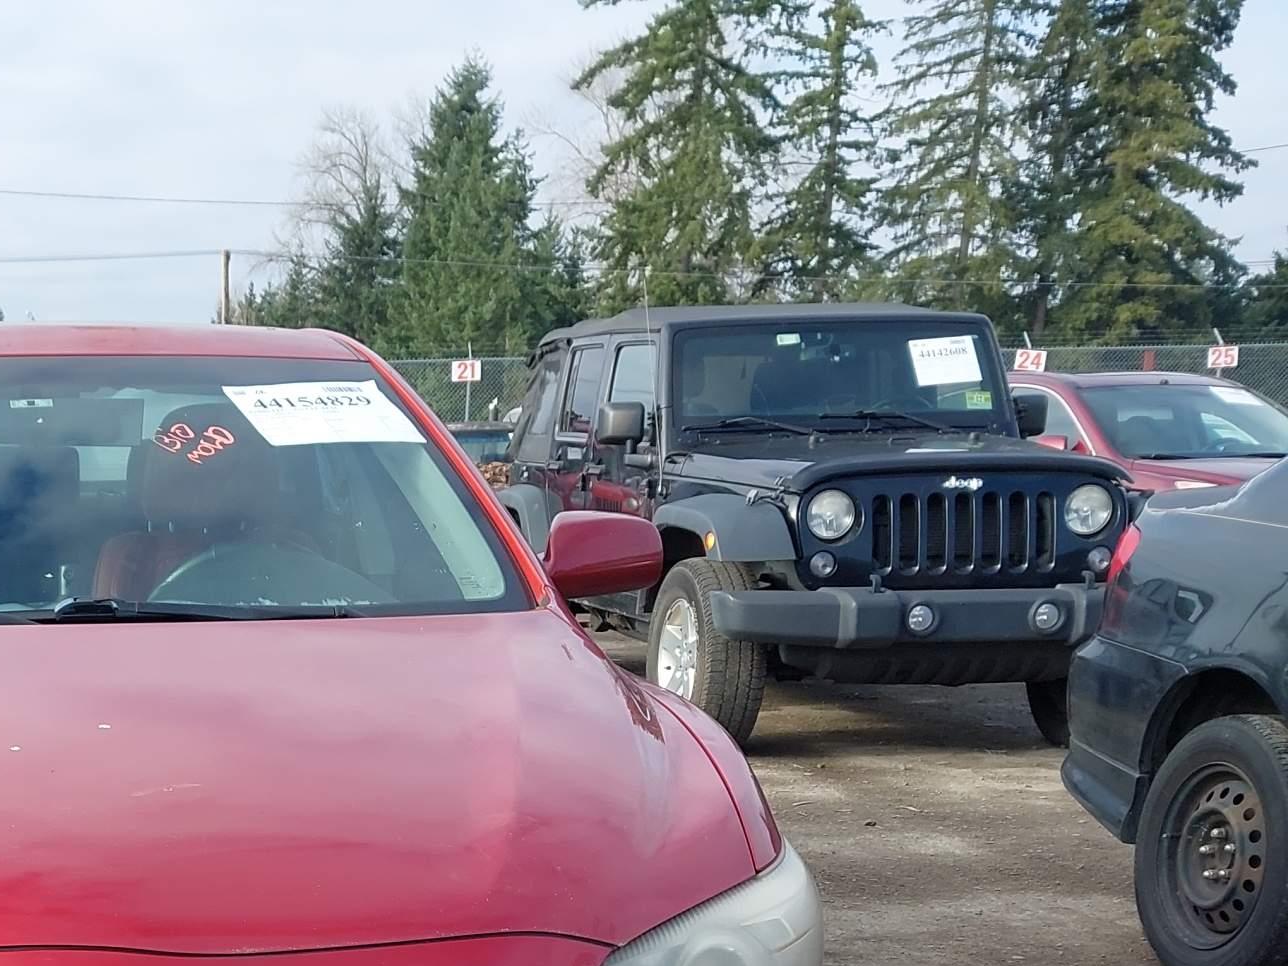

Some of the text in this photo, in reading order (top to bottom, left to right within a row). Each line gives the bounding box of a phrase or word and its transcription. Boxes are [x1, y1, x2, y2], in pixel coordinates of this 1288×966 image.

[919, 346, 968, 358] 44142608
[1017, 350, 1042, 370] 24
[1211, 347, 1235, 366] 25
[457, 361, 476, 380] 21
[253, 395, 372, 409] 44154829
[943, 475, 984, 491] Jeep
